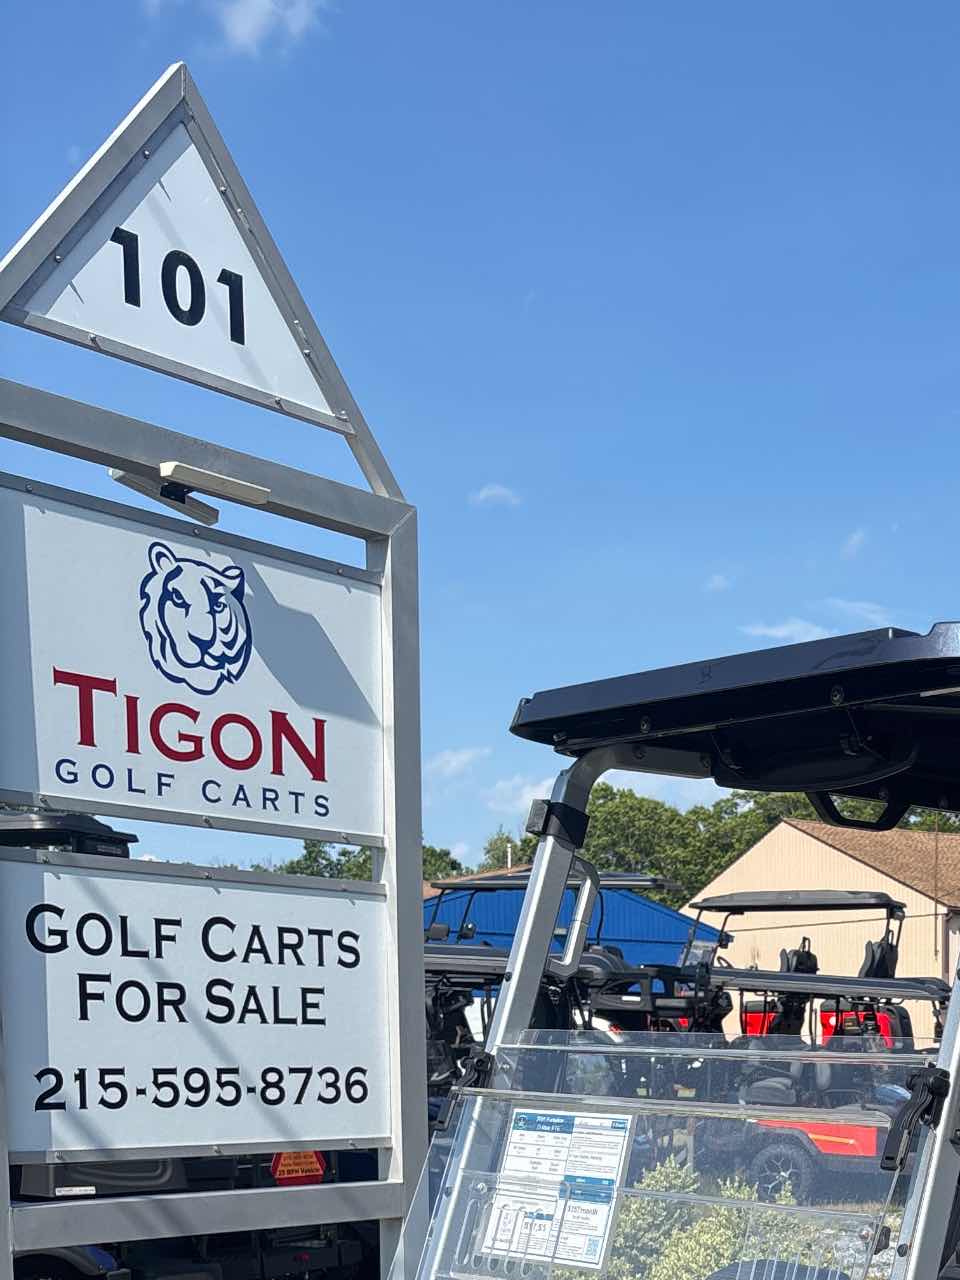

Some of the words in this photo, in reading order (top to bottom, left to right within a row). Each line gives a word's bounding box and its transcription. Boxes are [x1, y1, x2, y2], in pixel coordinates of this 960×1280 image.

[110, 226, 245, 345] 101
[52, 666, 327, 783] TIGON
[55, 758, 175, 797] GOLF
[201, 779, 330, 818] CARTS
[25, 903, 182, 960] GOLF
[201, 916, 361, 968] CARTS
[77, 973, 189, 1023] FOR
[205, 978, 326, 1026] SALE
[34, 1066, 369, 1112] 215-595-8736
